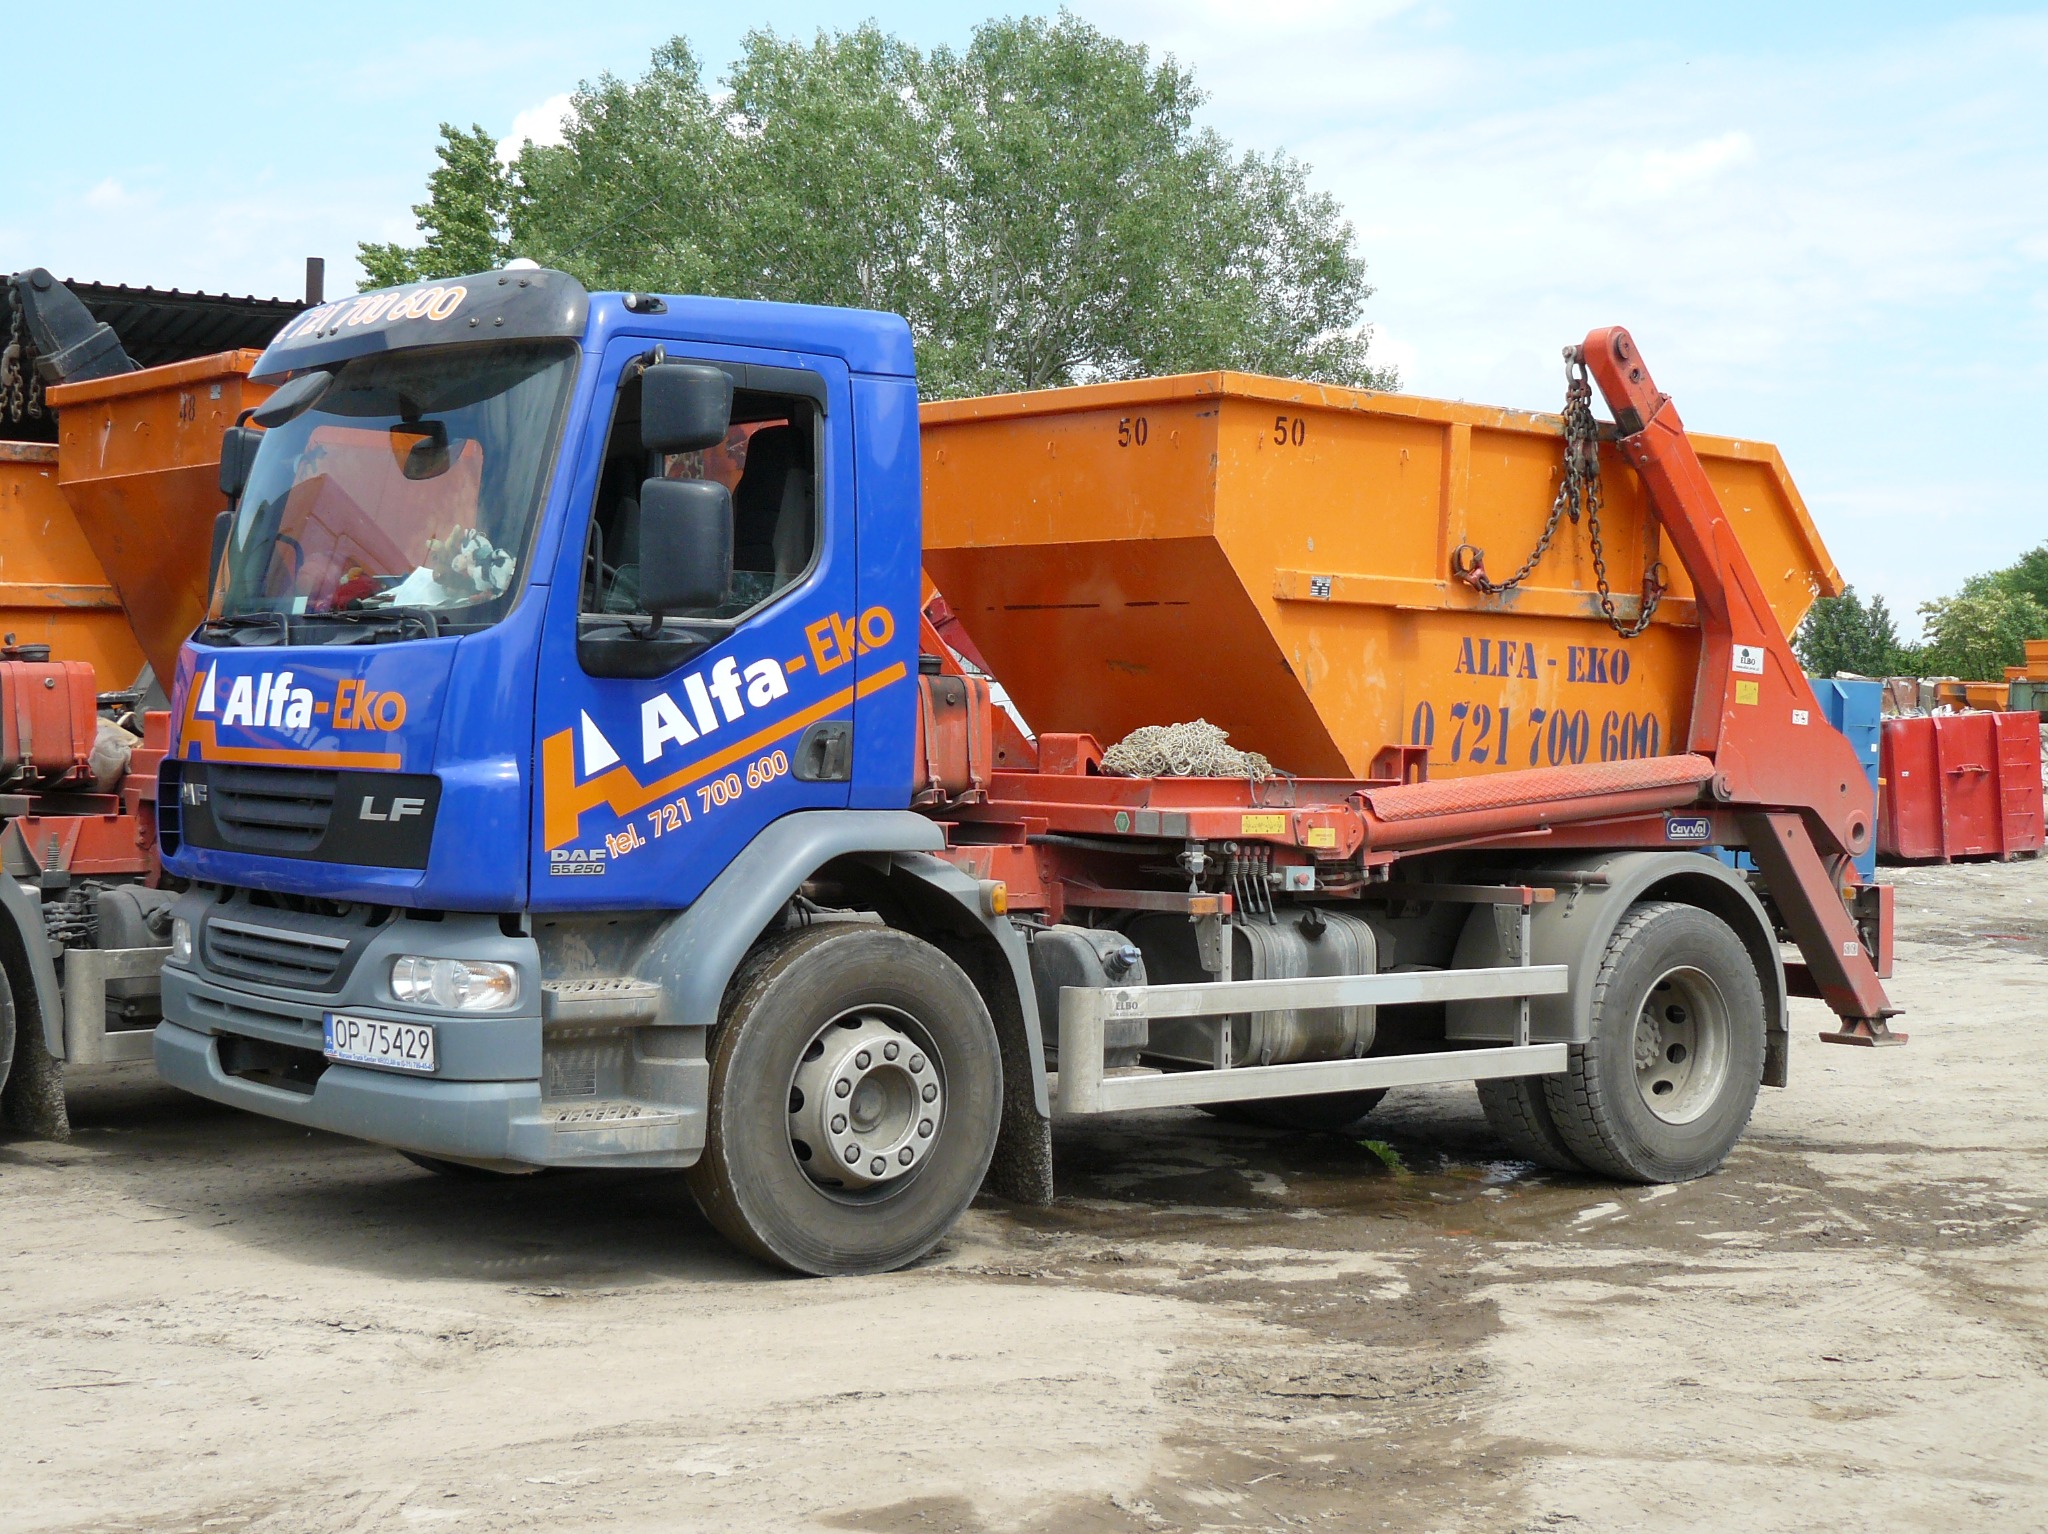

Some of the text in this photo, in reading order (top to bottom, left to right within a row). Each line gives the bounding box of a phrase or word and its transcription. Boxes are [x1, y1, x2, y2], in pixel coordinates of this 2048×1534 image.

[331, 292, 401, 329] 700
[387, 286, 467, 321] 600
[1118, 417, 1148, 447] 50
[1274, 416, 1306, 447] 50
[1454, 637, 1539, 679] ALFA
[1567, 645, 1630, 685] EKO
[222, 672, 407, 731] Alfa-Eko
[641, 606, 895, 764] Alfa-Eko
[1411, 701, 1660, 766] 0 721 700 600
[359, 796, 426, 822] LF
[606, 750, 788, 859] tel. 721 700 600
[551, 849, 606, 862] DAF
[551, 864, 604, 875] 55.250
[1116, 1002, 1138, 1010] ELBO
[367, 1023, 430, 1060] 75429
